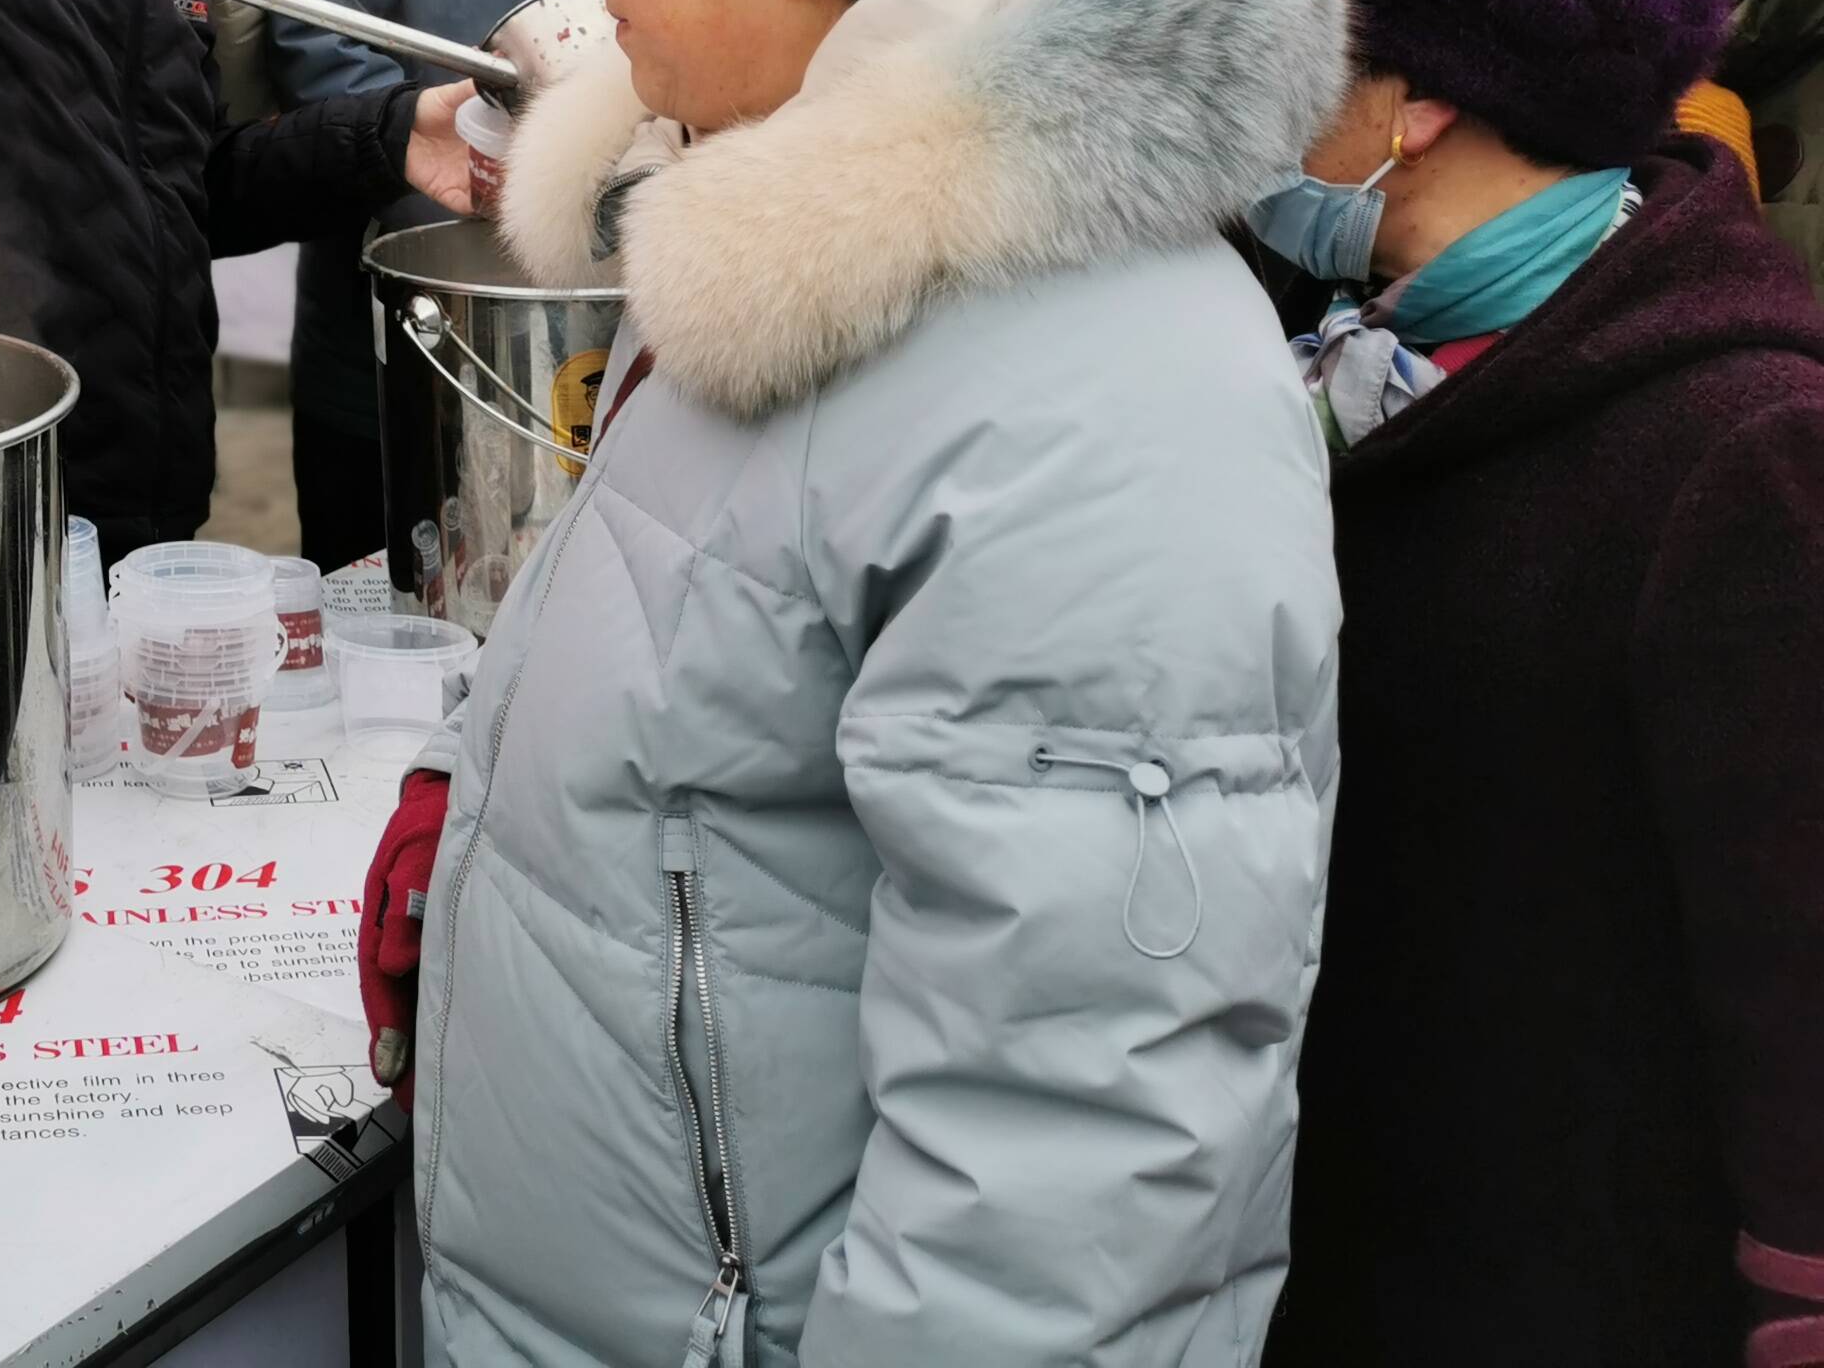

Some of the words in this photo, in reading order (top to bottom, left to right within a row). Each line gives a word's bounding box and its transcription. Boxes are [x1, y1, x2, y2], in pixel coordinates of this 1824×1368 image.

[139, 860, 278, 894] 304
[185, 936, 218, 947] the
[228, 930, 330, 946] protective
[206, 945, 263, 959] leave
[274, 943, 307, 954] the
[240, 960, 260, 970] to
[243, 967, 352, 983] bstances.
[33, 1033, 199, 1061] STEEL
[82, 1075, 122, 1087] film
[135, 1073, 155, 1085] in
[167, 1070, 226, 1083] three
[5, 1094, 42, 1107] the
[54, 1090, 139, 1106] factory.
[0, 1108, 106, 1124] sunshine
[119, 1105, 165, 1118] and
[176, 1102, 235, 1117] keep
